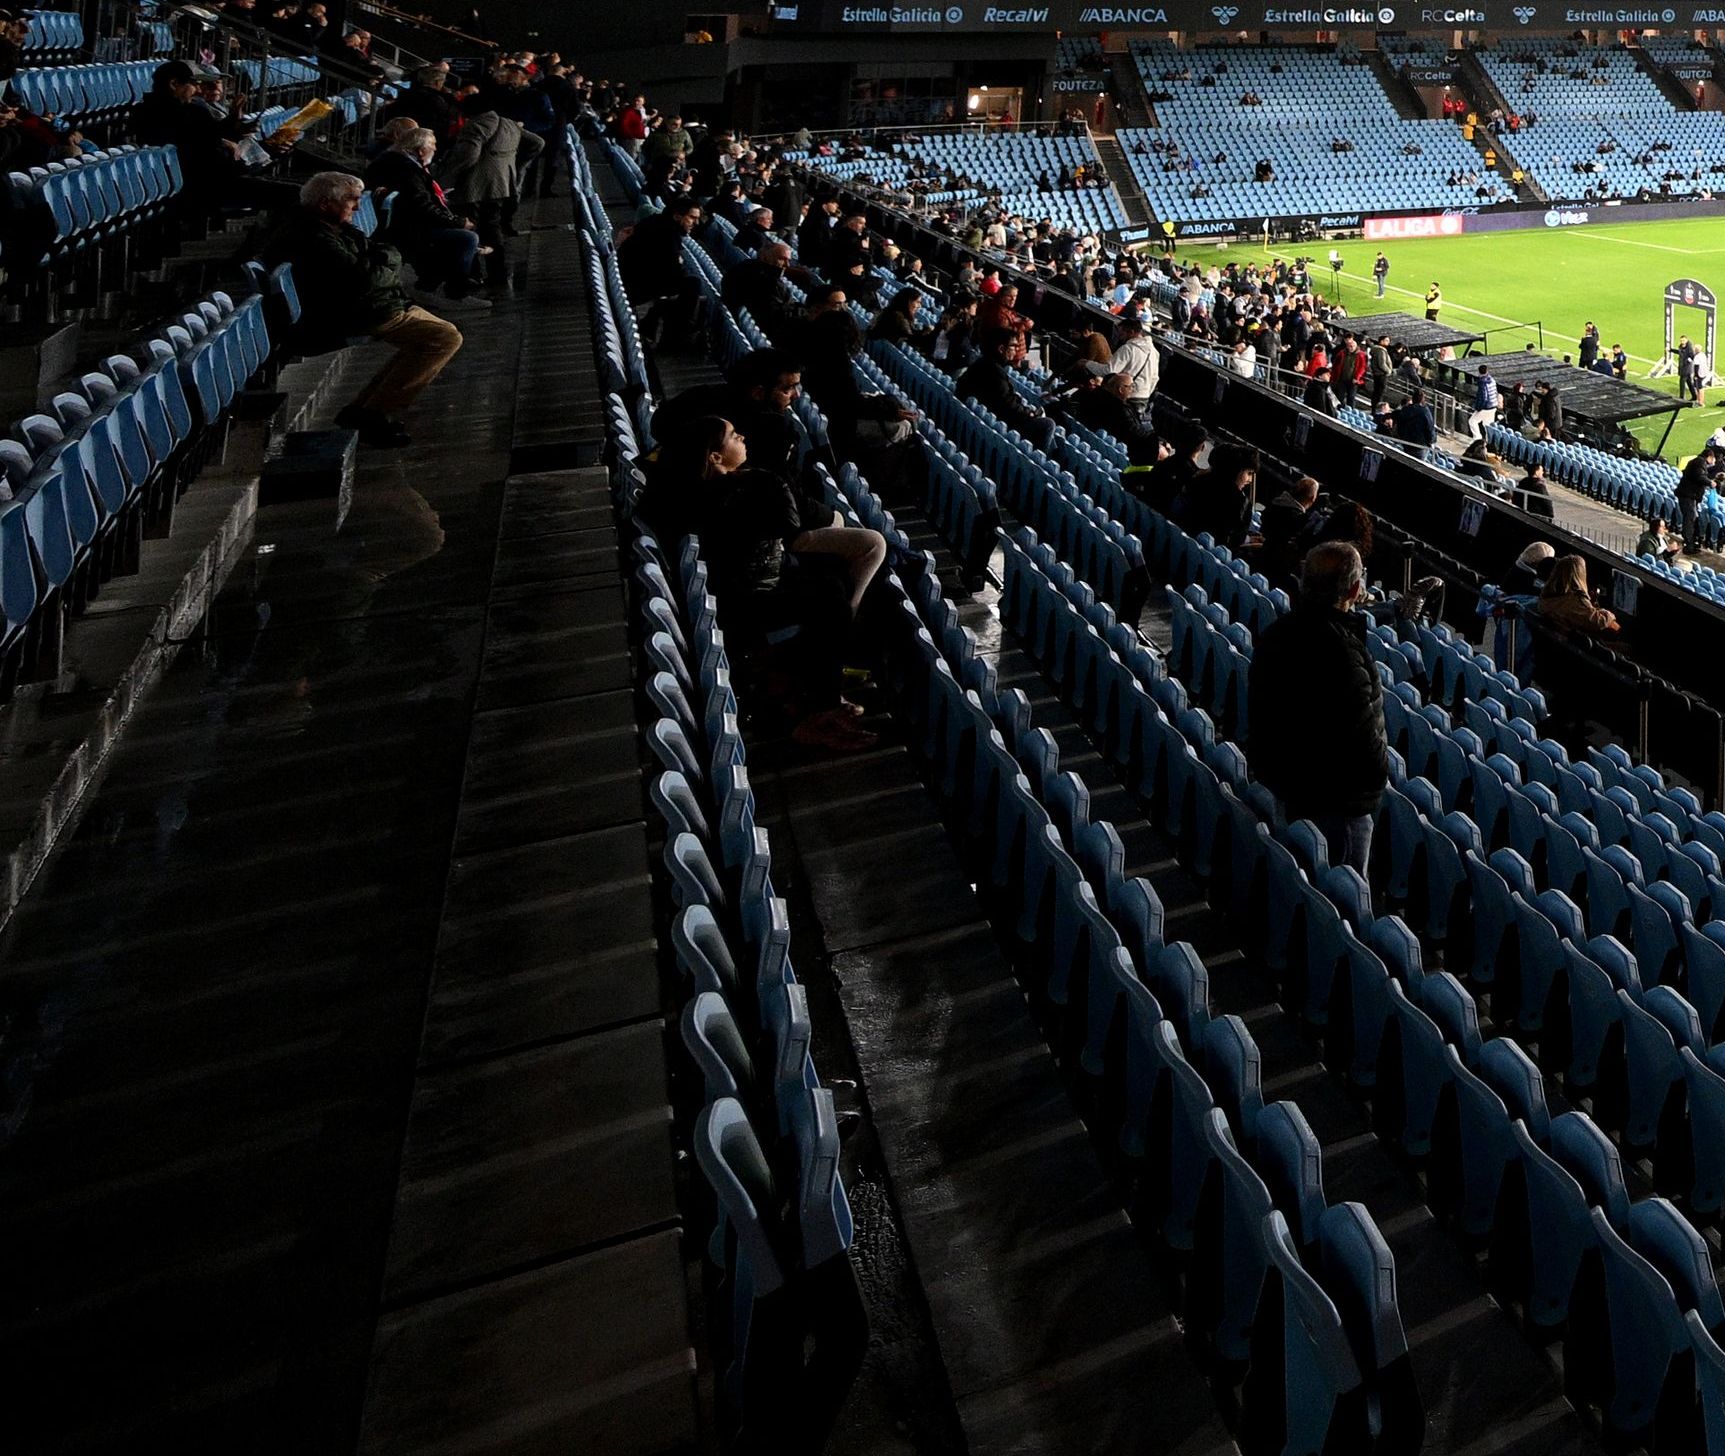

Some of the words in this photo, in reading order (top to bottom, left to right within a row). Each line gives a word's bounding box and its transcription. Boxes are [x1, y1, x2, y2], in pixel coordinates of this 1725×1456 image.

[842, 7, 887, 23] Estrella
[889, 7, 941, 23] Galicia
[984, 7, 1049, 23] Recalvi
[1088, 8, 1168, 23] ABANCA
[1264, 8, 1320, 23] Estrella
[1323, 7, 1374, 23] Galicia
[1566, 10, 1613, 22] Estrella
[1616, 10, 1659, 23] Galicia
[1053, 79, 1104, 92] FOUTEZA
[1186, 222, 1236, 235] ABANCA
[1320, 216, 1359, 228] Recalvi
[1369, 217, 1436, 237] LALIGA
